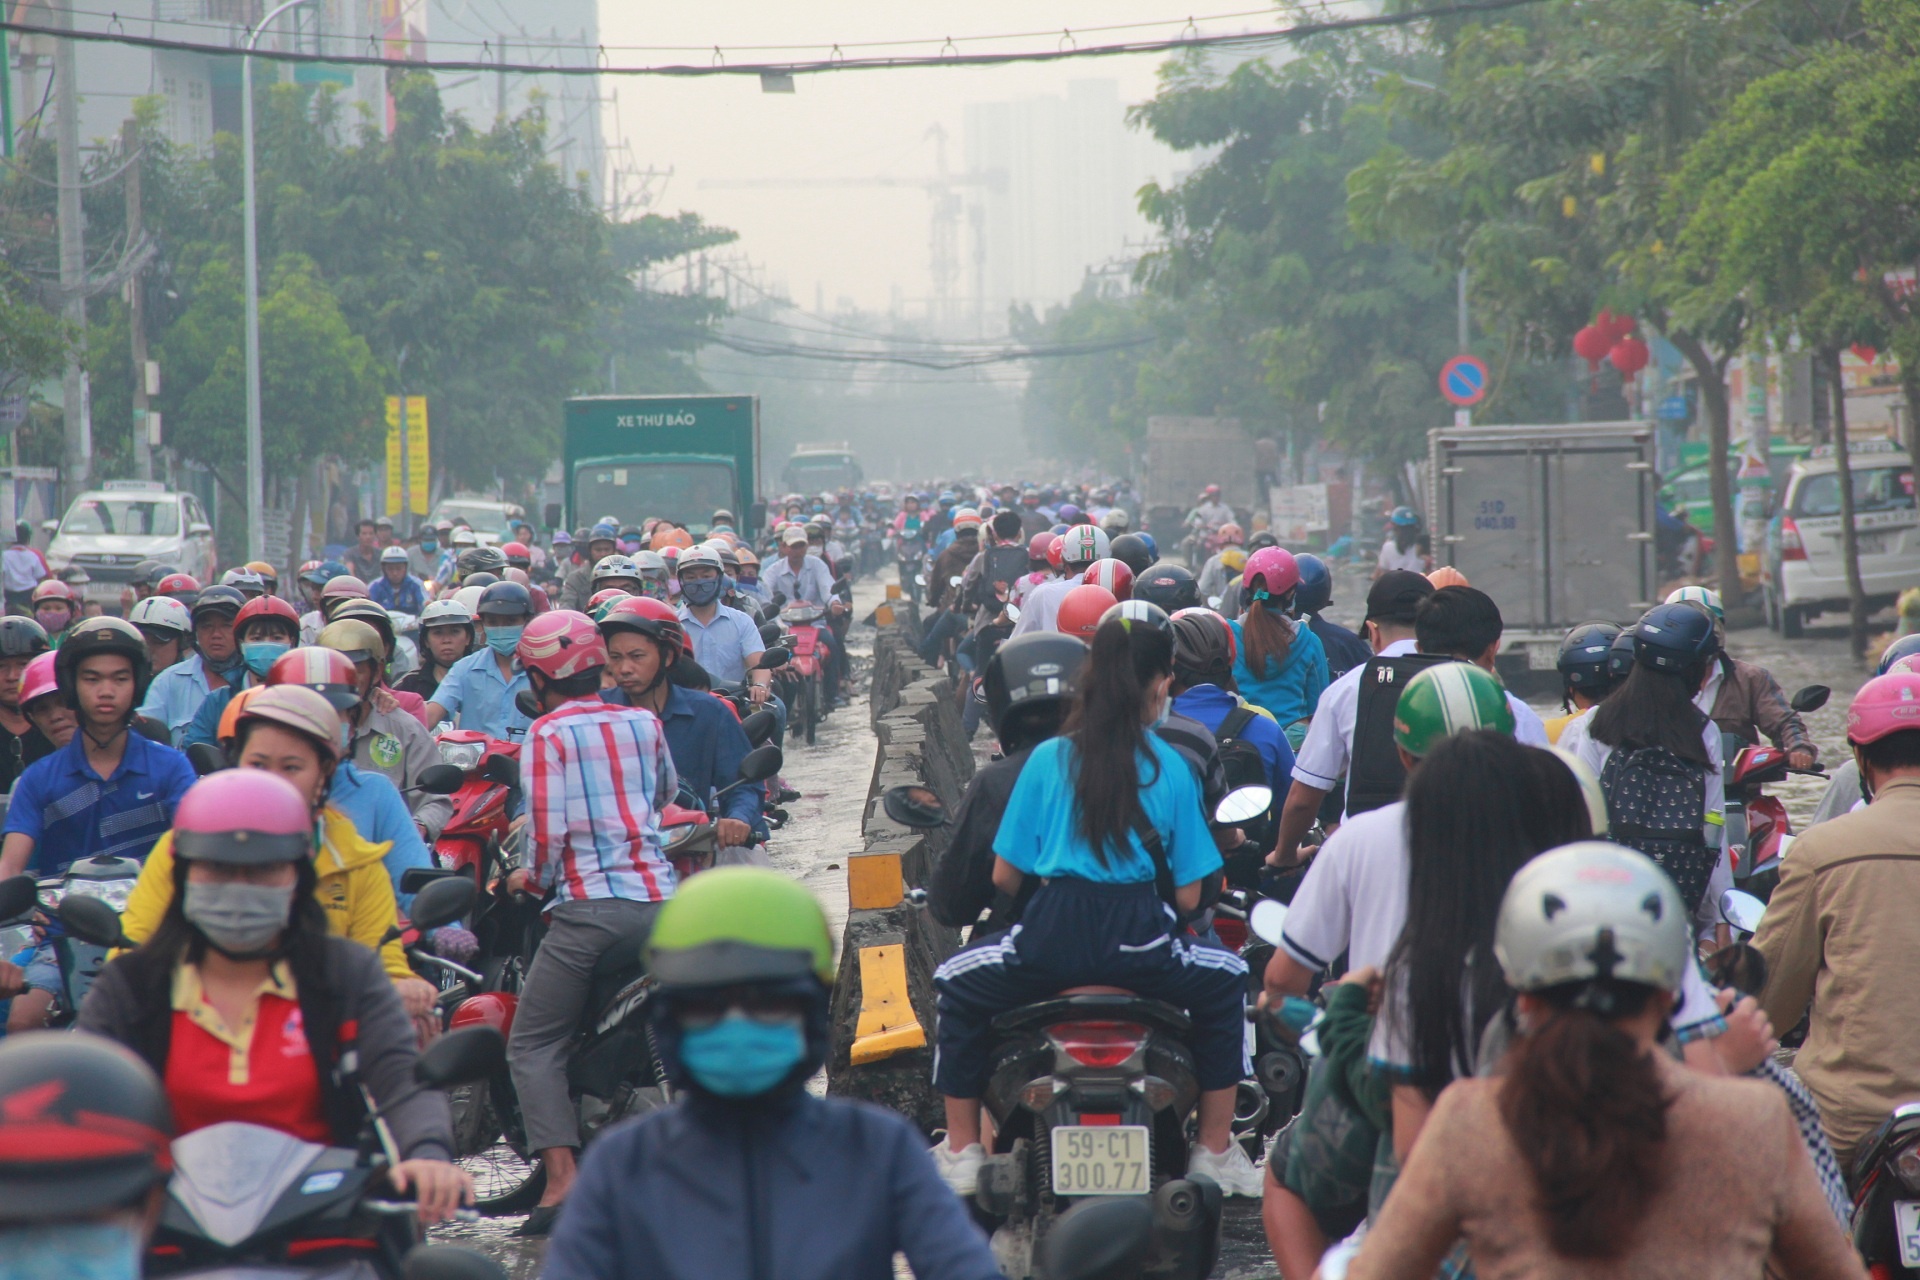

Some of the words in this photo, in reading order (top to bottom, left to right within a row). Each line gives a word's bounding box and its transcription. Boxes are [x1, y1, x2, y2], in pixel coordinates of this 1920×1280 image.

[617, 415, 634, 427] XE
[636, 414, 664, 426] THƯ
[666, 409, 695, 426] BÁO
[376, 736, 400, 754] PJK
[1068, 1131, 1131, 1158] 59-C1
[1060, 1162, 1143, 1189] 300.77
